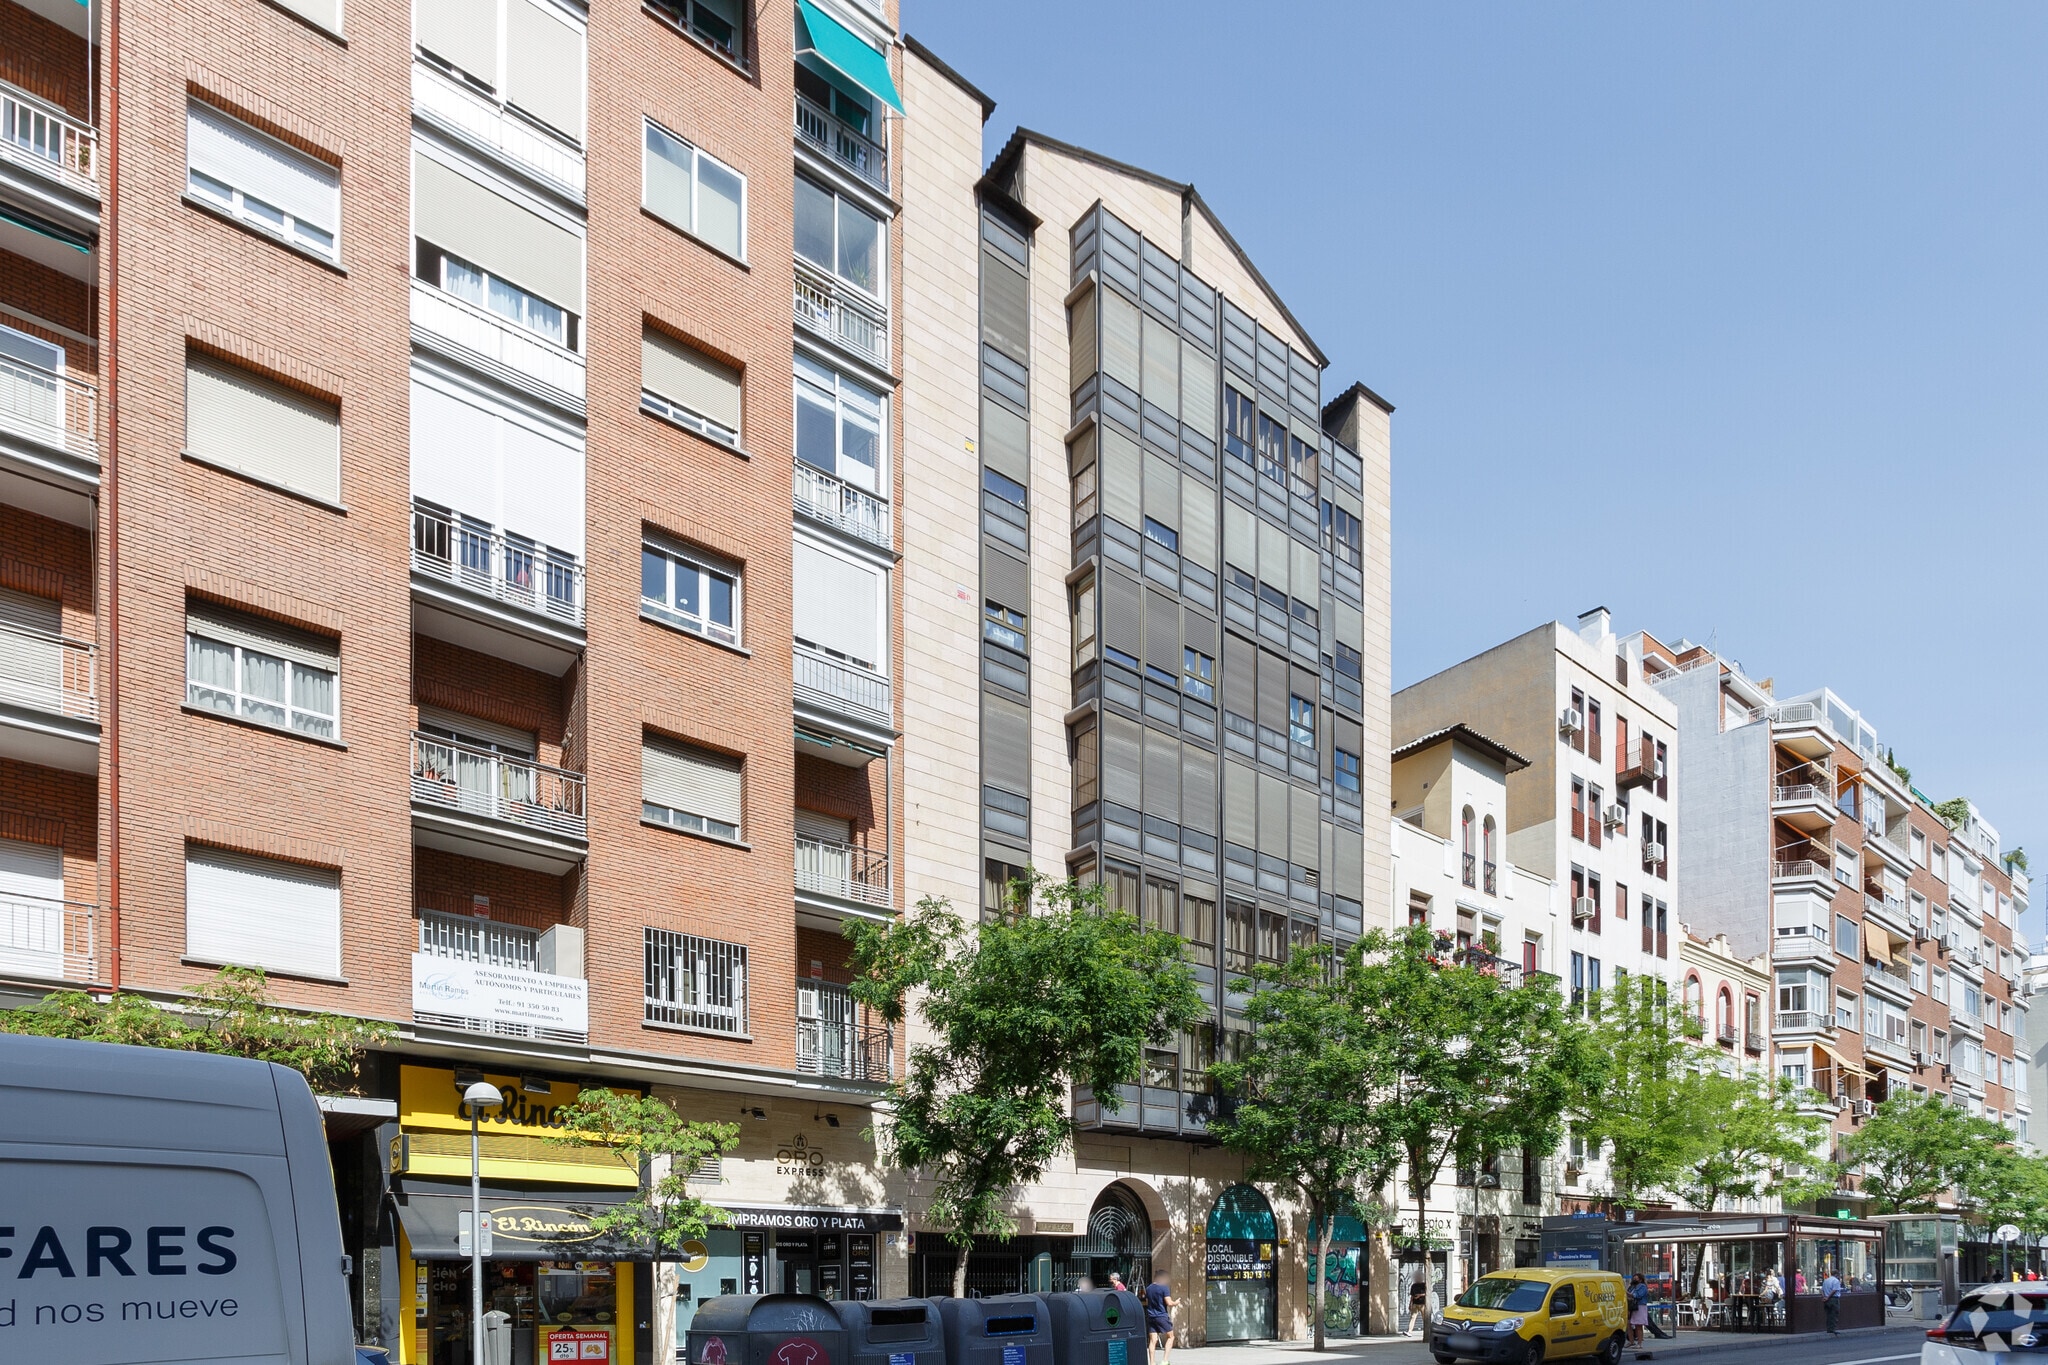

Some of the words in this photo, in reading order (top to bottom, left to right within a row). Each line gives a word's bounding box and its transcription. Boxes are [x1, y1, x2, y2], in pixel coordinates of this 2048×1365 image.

[474, 970, 537, 985] ASESORAMIENTO
[545, 980, 582, 992] EMPRESAS
[530, 987, 582, 1000] PARTICULARES
[776, 1149, 824, 1166] ORO
[776, 1166, 824, 1177] EXPRESS
[492, 1216, 520, 1232] El
[520, 1217, 592, 1233] Rincón
[794, 1215, 819, 1228] ORO
[820, 1217, 829, 1228] Y
[831, 1217, 865, 1229] PLATA
[1401, 1217, 1444, 1230] conepto
[1207, 1244, 1234, 1253] LOCAL
[1207, 1254, 1254, 1263] DISPONIBLE
[1207, 1263, 1221, 1271] CON
[1252, 1262, 1271, 1270] HUMOS
[1233, 1271, 1241, 1279] 91
[35, 1302, 105, 1325] nos
[122, 1298, 239, 1321] mueve
